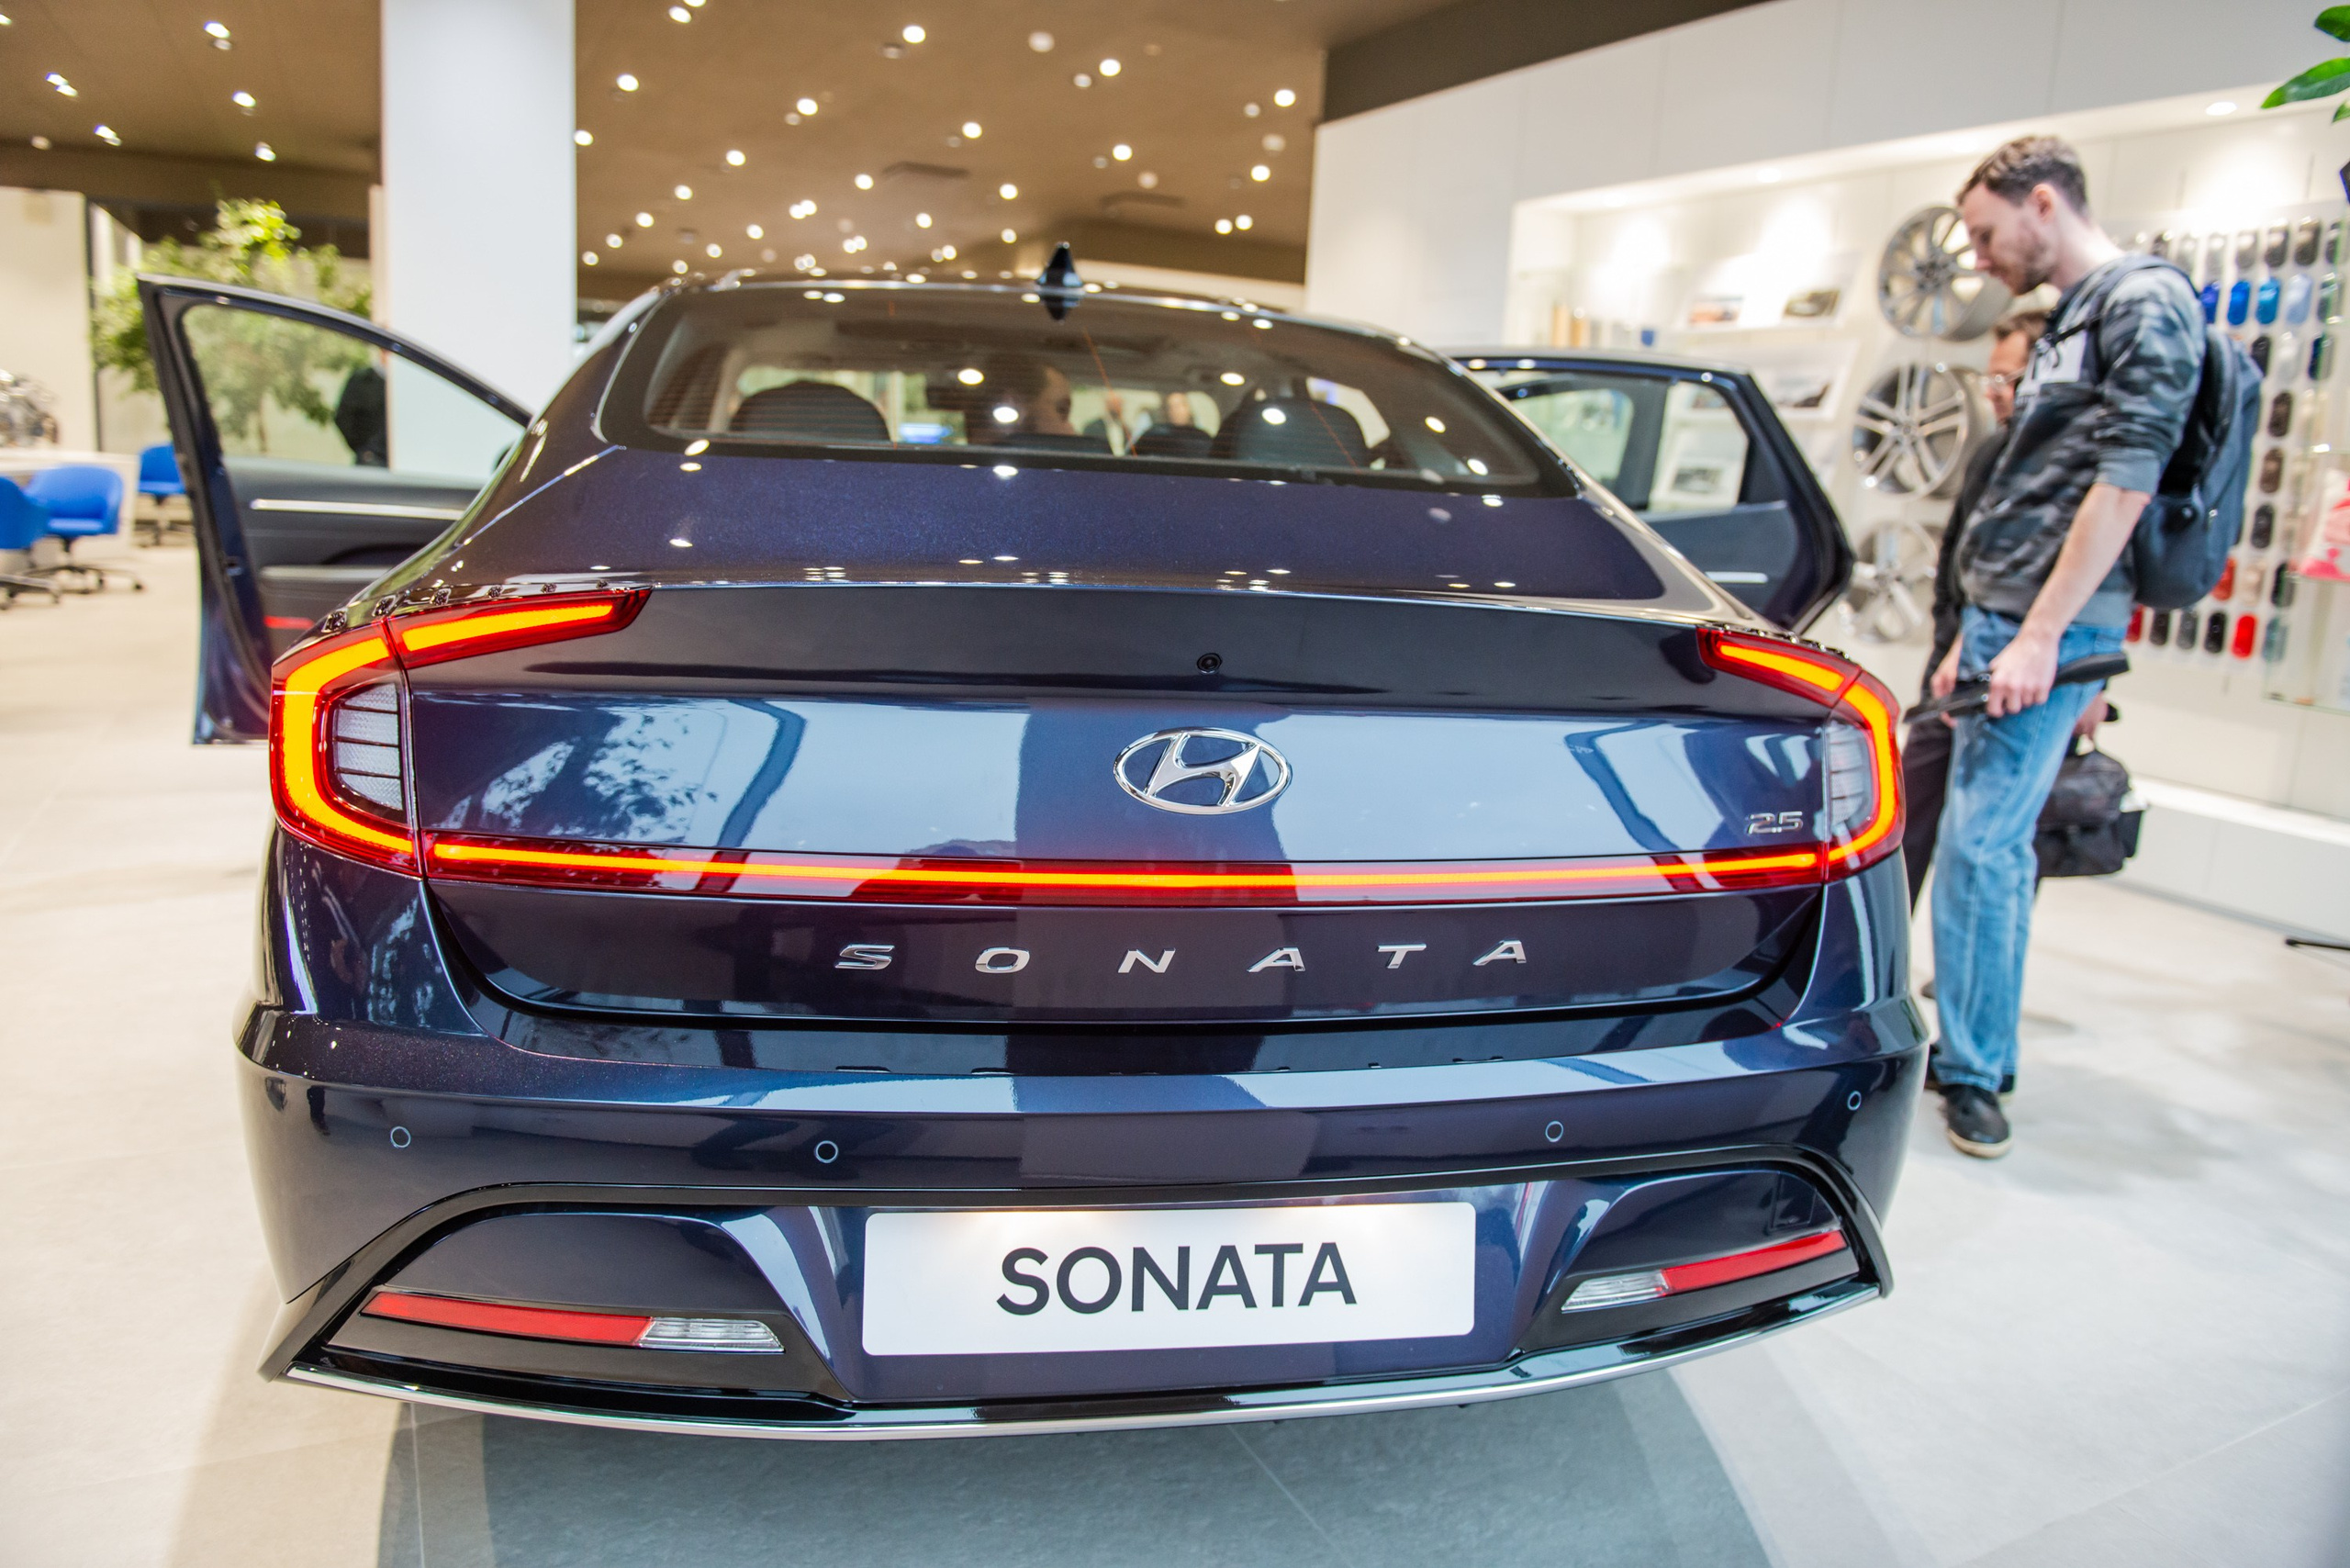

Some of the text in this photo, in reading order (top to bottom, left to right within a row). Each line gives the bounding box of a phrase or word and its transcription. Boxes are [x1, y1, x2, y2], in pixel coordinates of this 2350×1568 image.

[1748, 811, 1803, 834] 2.5
[834, 939, 1528, 974] SONATA
[996, 1241, 1358, 1316] SONATA
